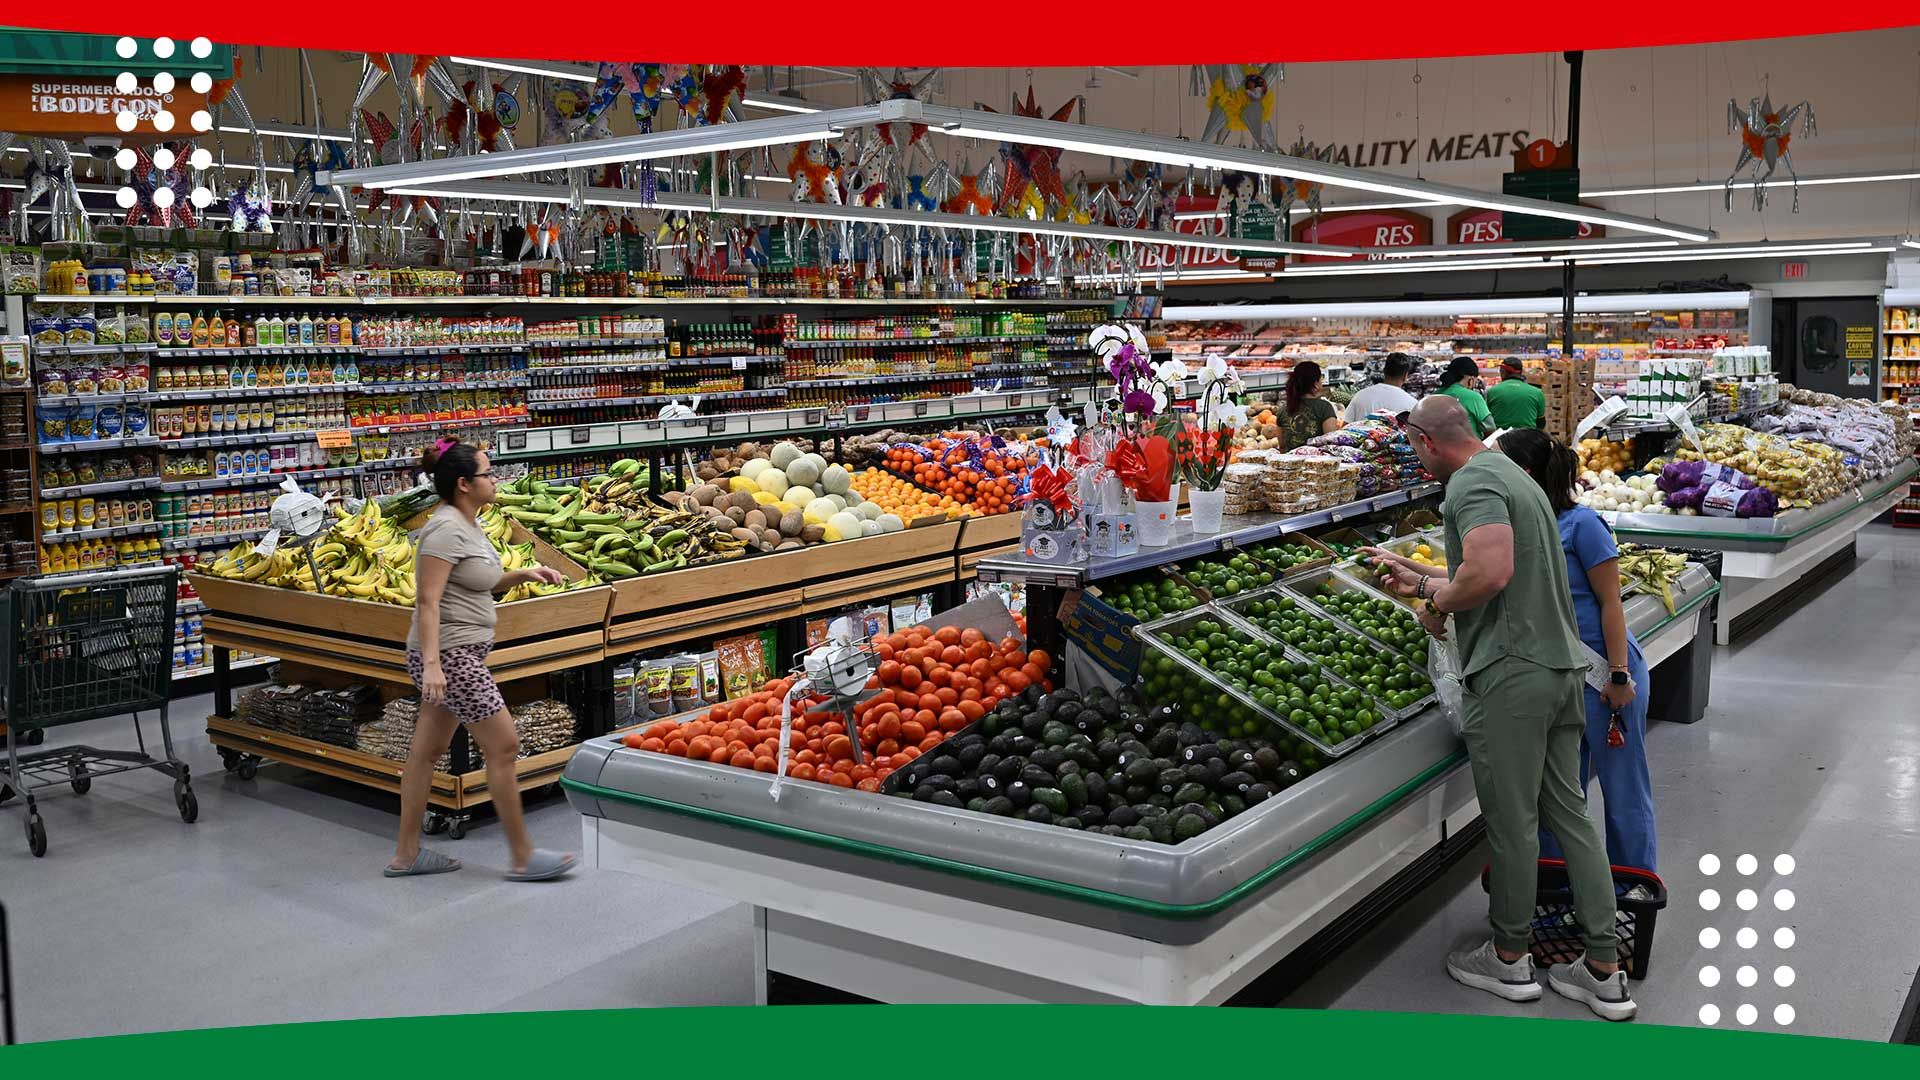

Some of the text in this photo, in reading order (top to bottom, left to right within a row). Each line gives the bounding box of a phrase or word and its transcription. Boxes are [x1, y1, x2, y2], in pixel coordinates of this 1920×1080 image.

[32, 83, 162, 96] SUPERMERCDOS
[1328, 130, 1530, 169] ALITY MEATS
[1535, 144, 1545, 162] 1
[1374, 224, 1415, 247] RES
[1785, 263, 1805, 277] EXIT
